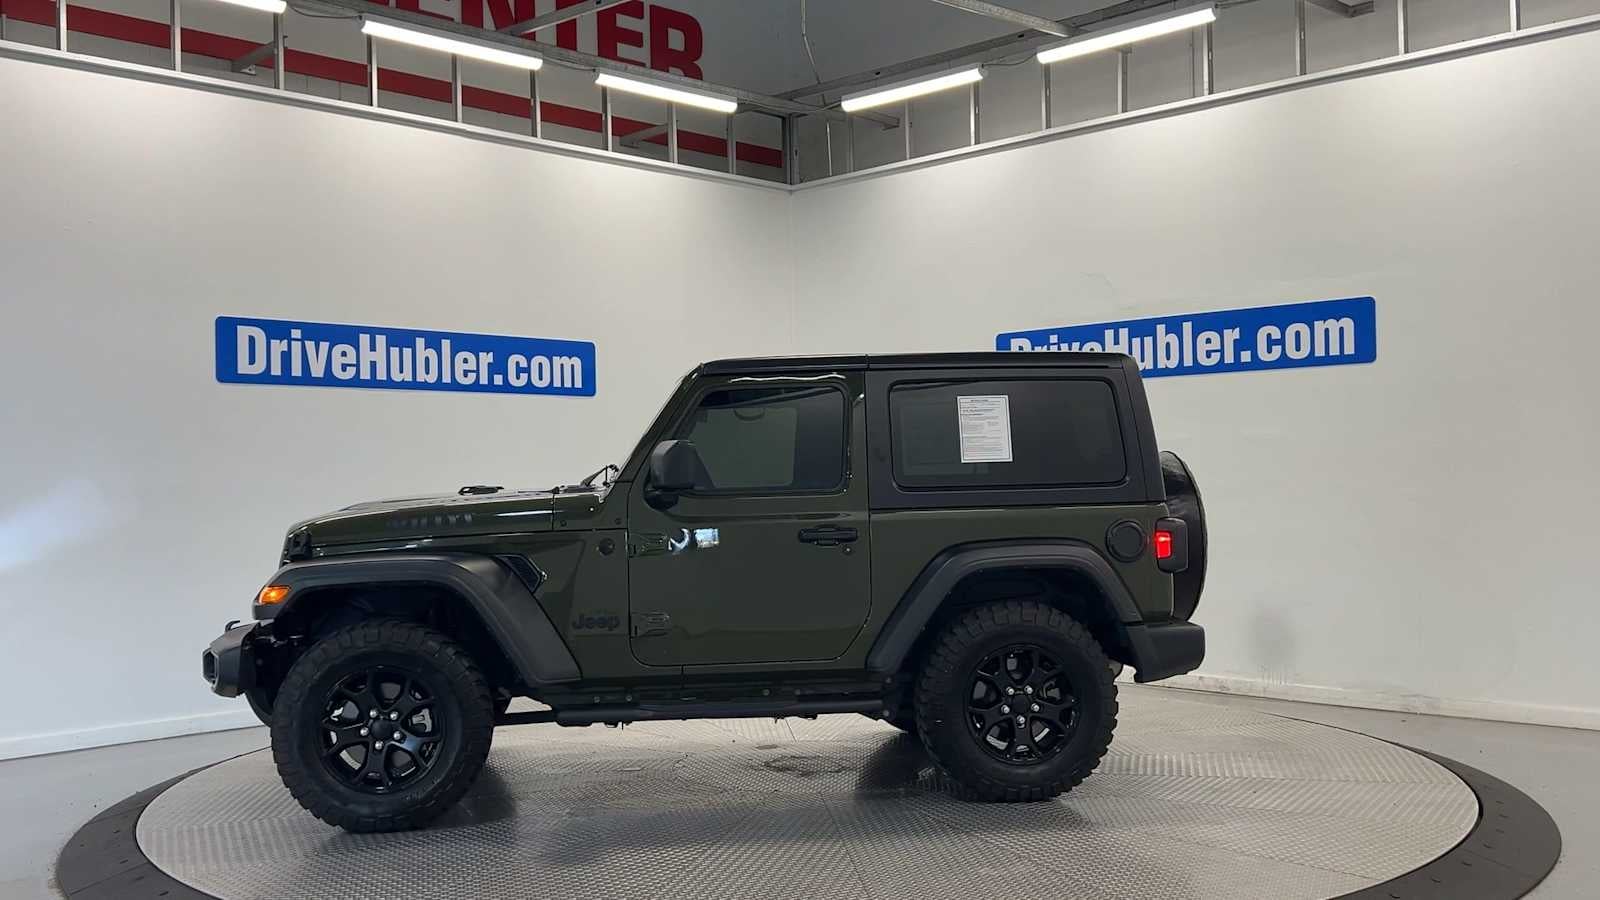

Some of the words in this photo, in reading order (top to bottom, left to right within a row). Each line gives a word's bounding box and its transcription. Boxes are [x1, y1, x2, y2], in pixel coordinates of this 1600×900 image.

[366, 0, 703, 81] NTER
[236, 324, 583, 389] DriveHubler.com
[1009, 315, 1356, 370] Hubler.com
[571, 612, 621, 632] Jeep
